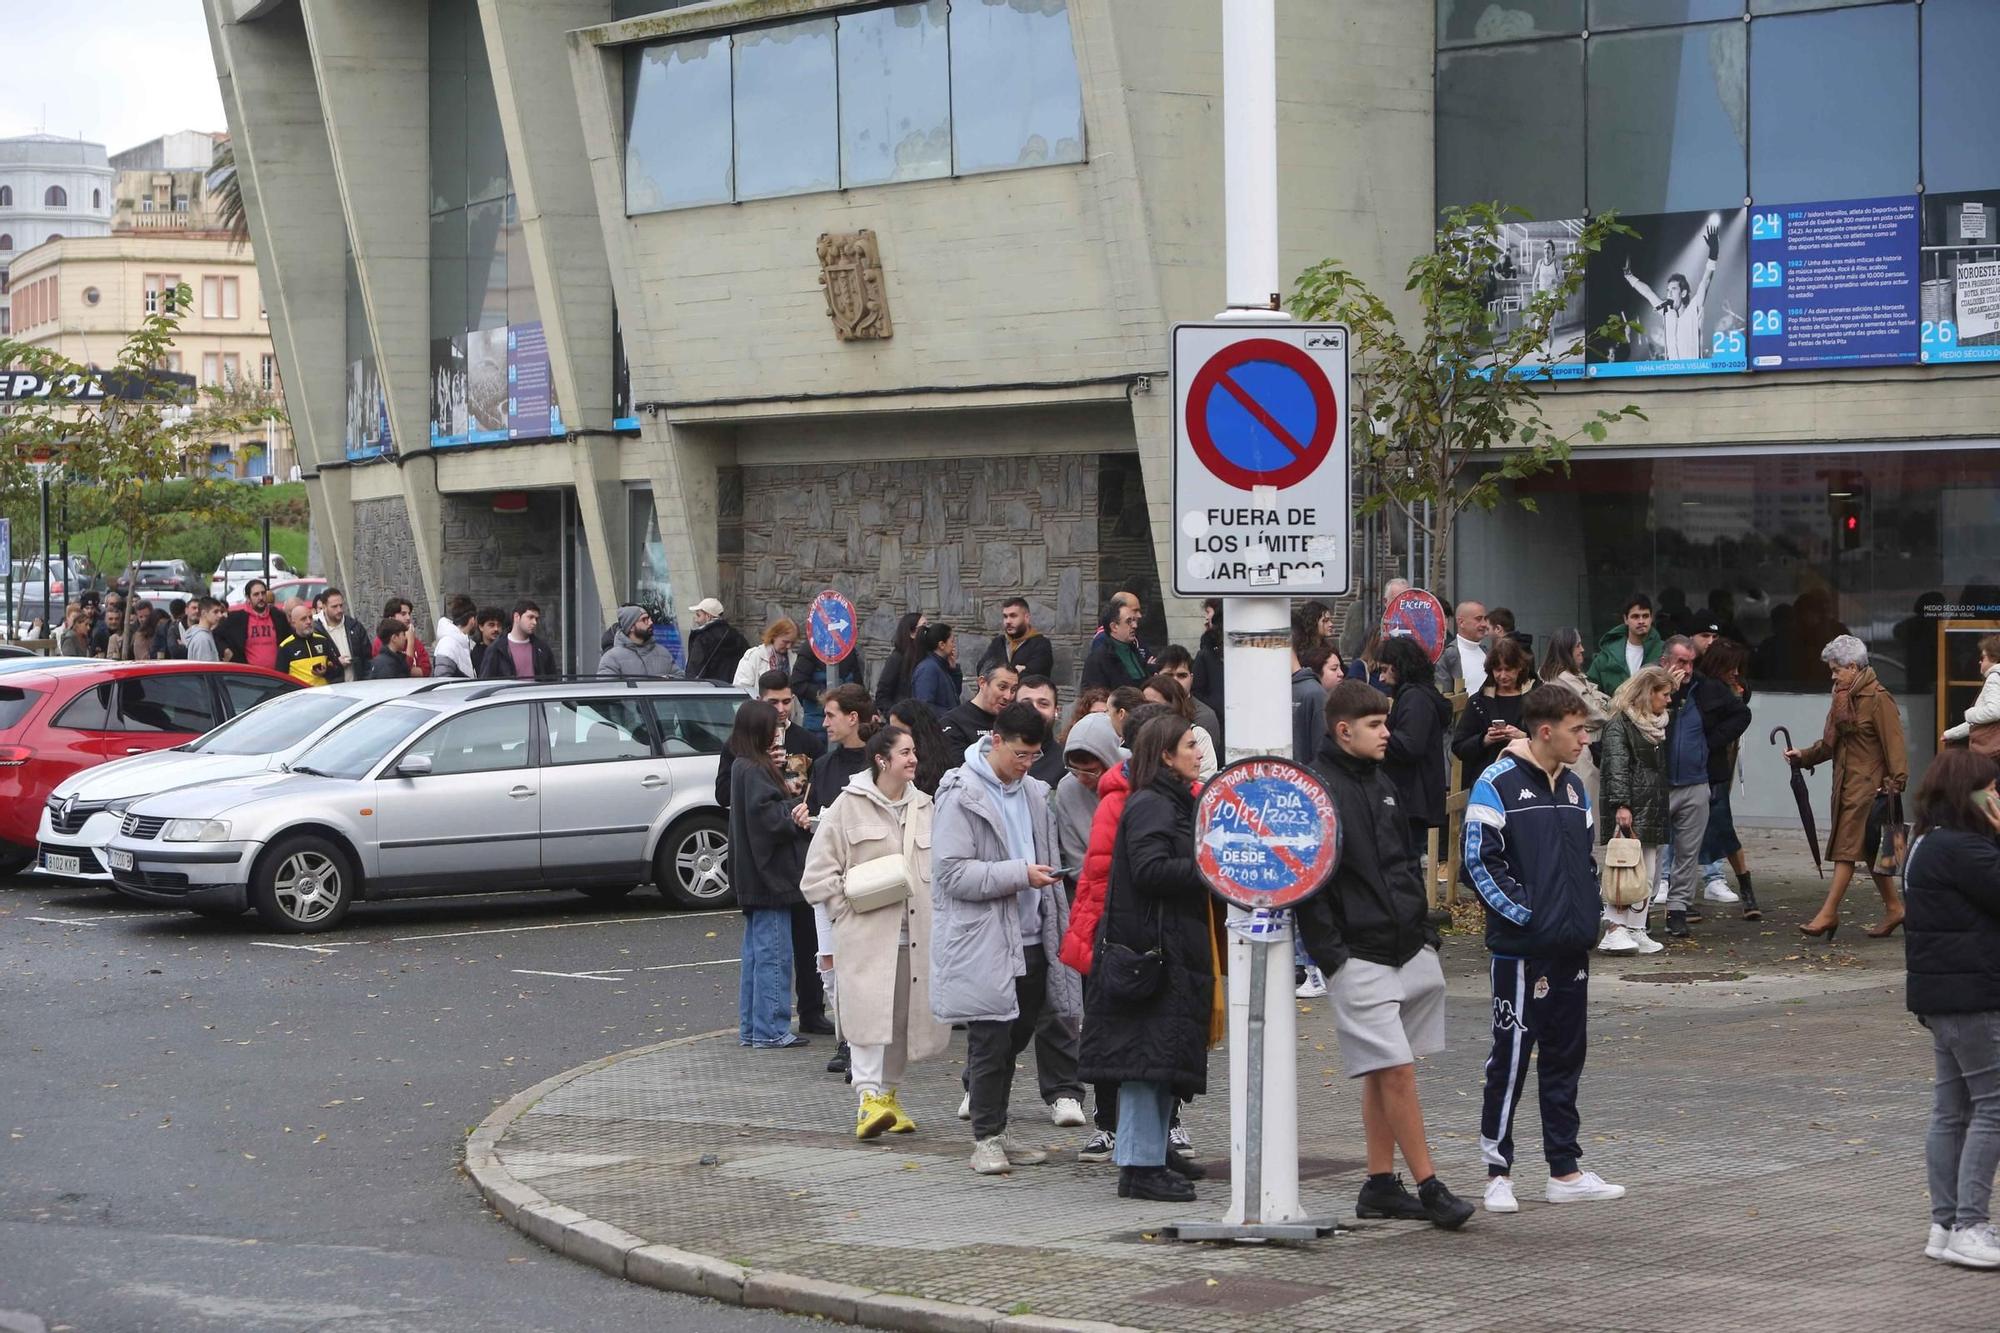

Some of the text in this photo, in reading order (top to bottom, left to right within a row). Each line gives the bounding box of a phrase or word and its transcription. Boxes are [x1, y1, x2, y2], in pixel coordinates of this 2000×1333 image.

[1752, 213, 1780, 235] 24
[1753, 261, 1779, 282] 25
[1958, 266, 1996, 279] NOROESTE
[1752, 310, 1779, 330] 26
[1714, 331, 1741, 352] 25
[1922, 320, 1952, 344] 26
[1940, 351, 1962, 359] MEDIO
[1964, 349, 1992, 358] SÉCULO
[1208, 509, 1316, 525] FUERA DE
[1196, 530, 1330, 552] LOS LÍMITE
[1222, 767, 1249, 786] TODA
[1277, 791, 1302, 808] DÍA
[1212, 797, 1310, 832] 10/12/2023
[1223, 851, 1266, 862] DESDE
